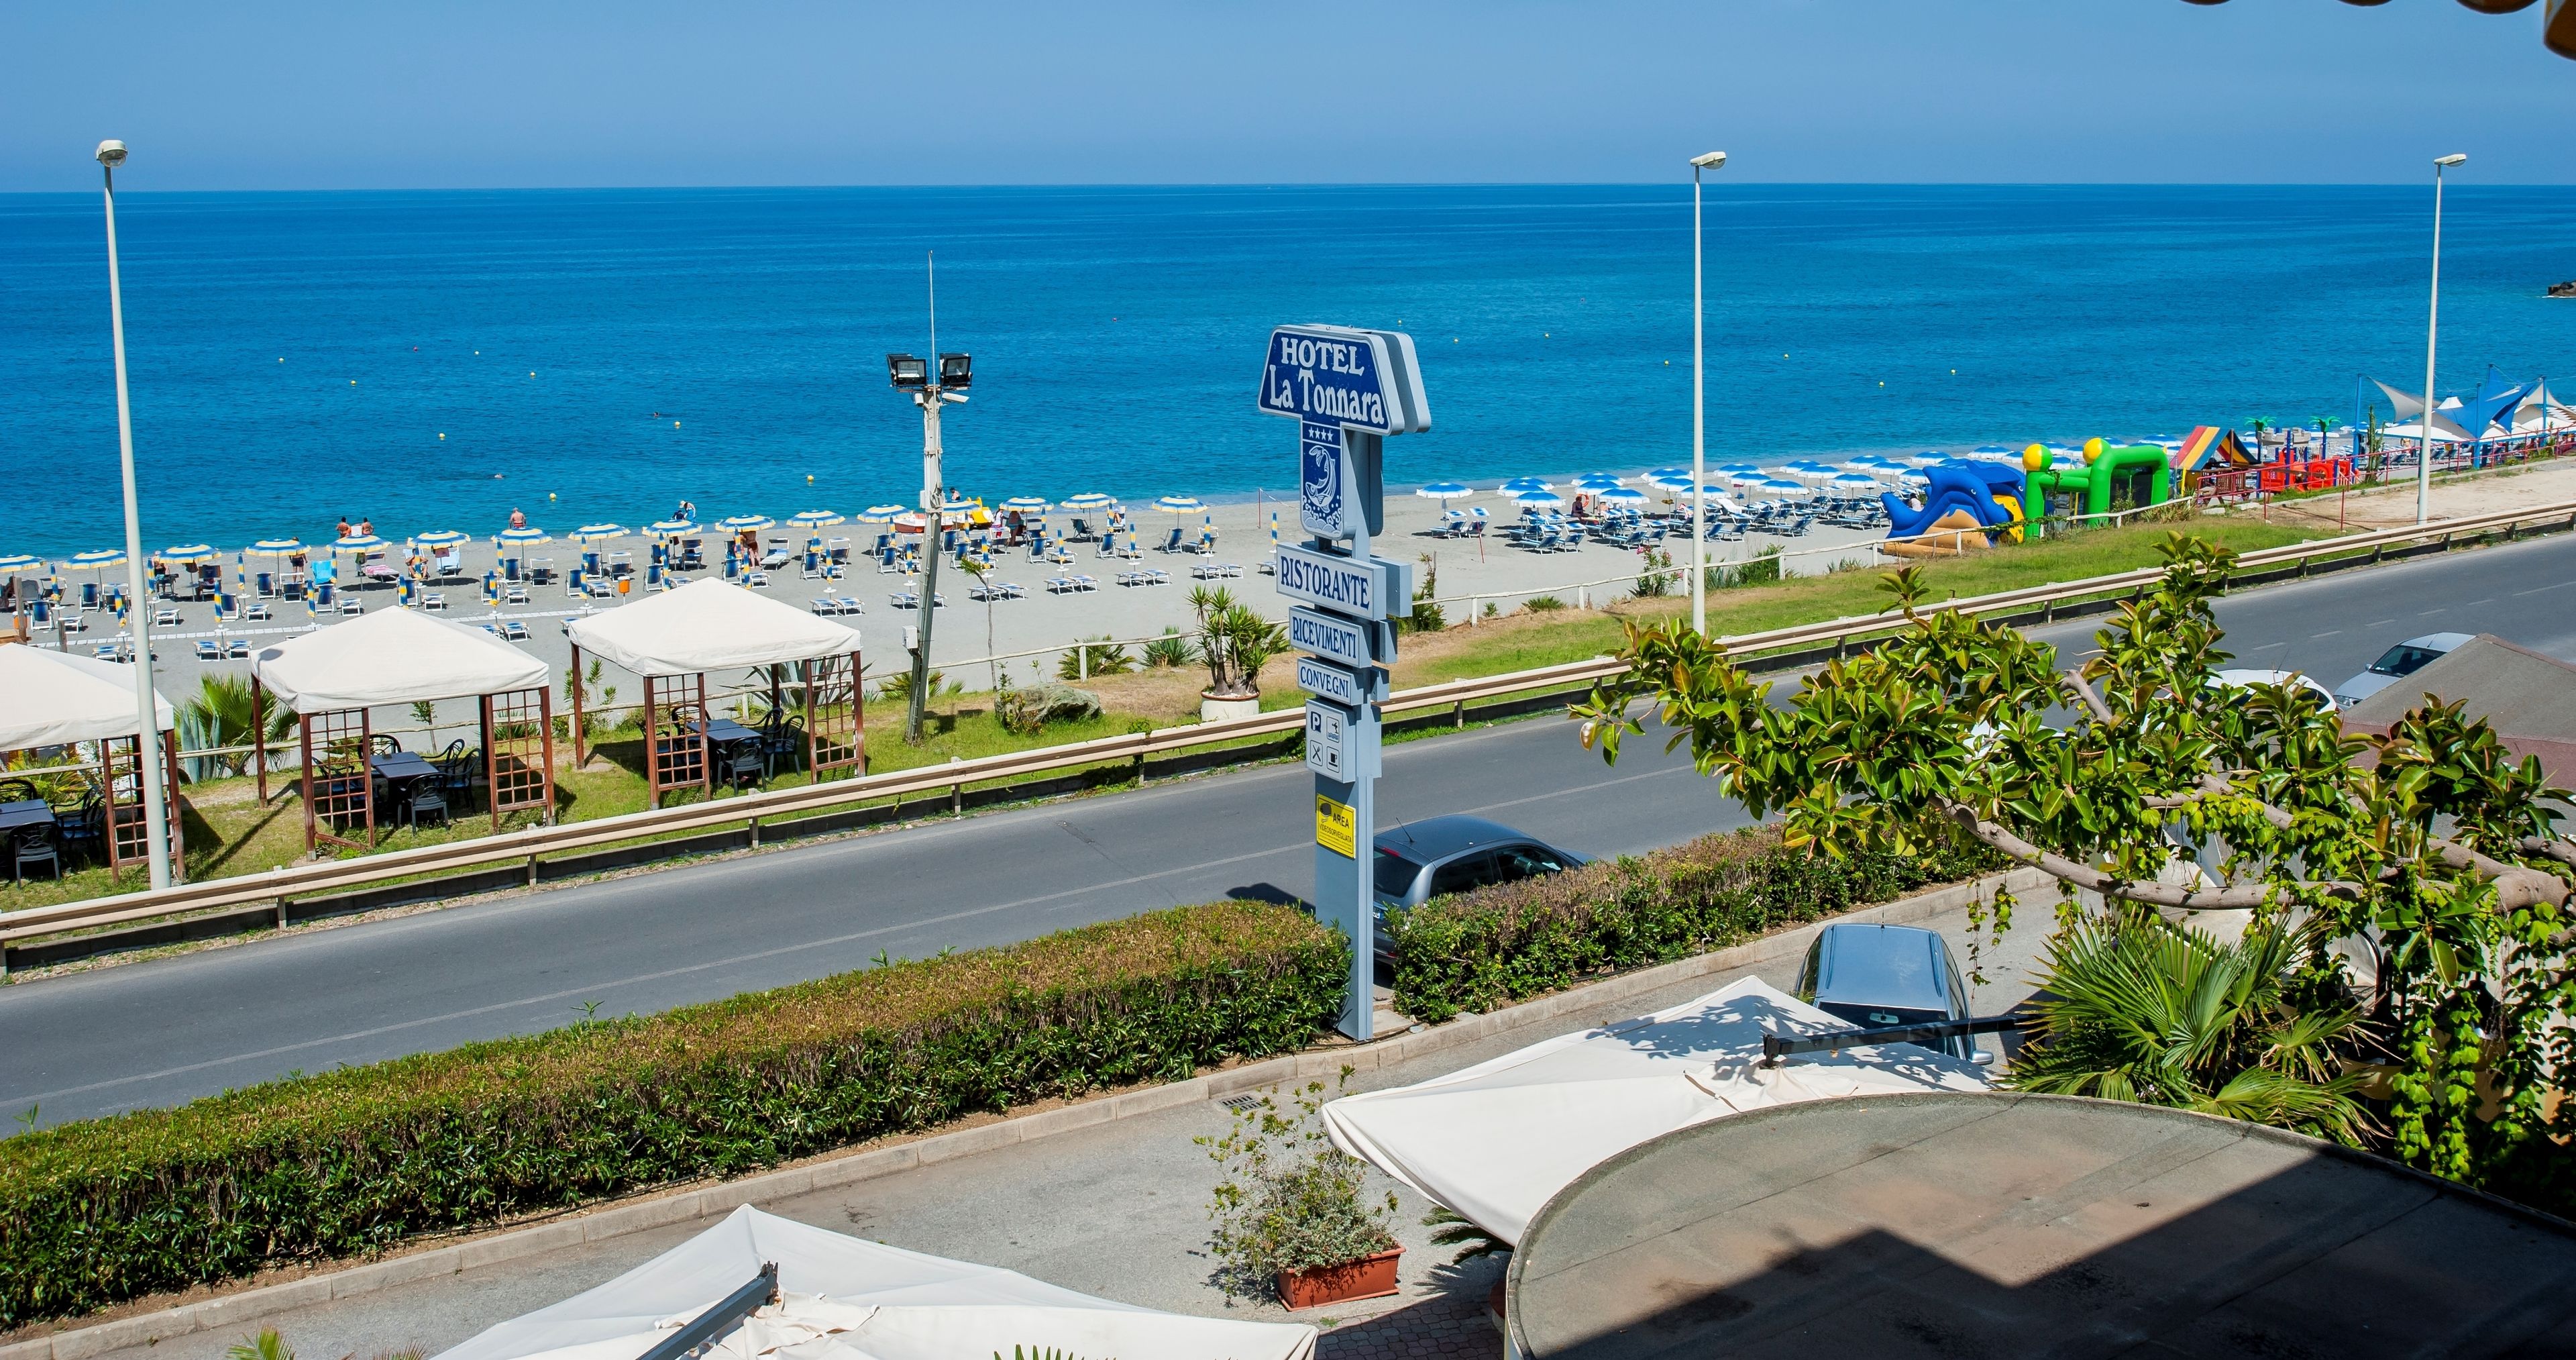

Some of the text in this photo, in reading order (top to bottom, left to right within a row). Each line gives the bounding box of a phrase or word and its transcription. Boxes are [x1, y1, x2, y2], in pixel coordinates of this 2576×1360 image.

[1281, 337, 1364, 376] HOTEL
[1269, 364, 1385, 425] La Tonnara
[1281, 556, 1370, 611] RISTORANTE
[1293, 617, 1356, 659] RICEVIMENTI
[1300, 666, 1349, 698] CONVEGNI
[1312, 713, 1320, 731] P
[1320, 823, 1352, 843] VIDEOSORVEGLIATA
[1332, 813, 1350, 829] AREA
